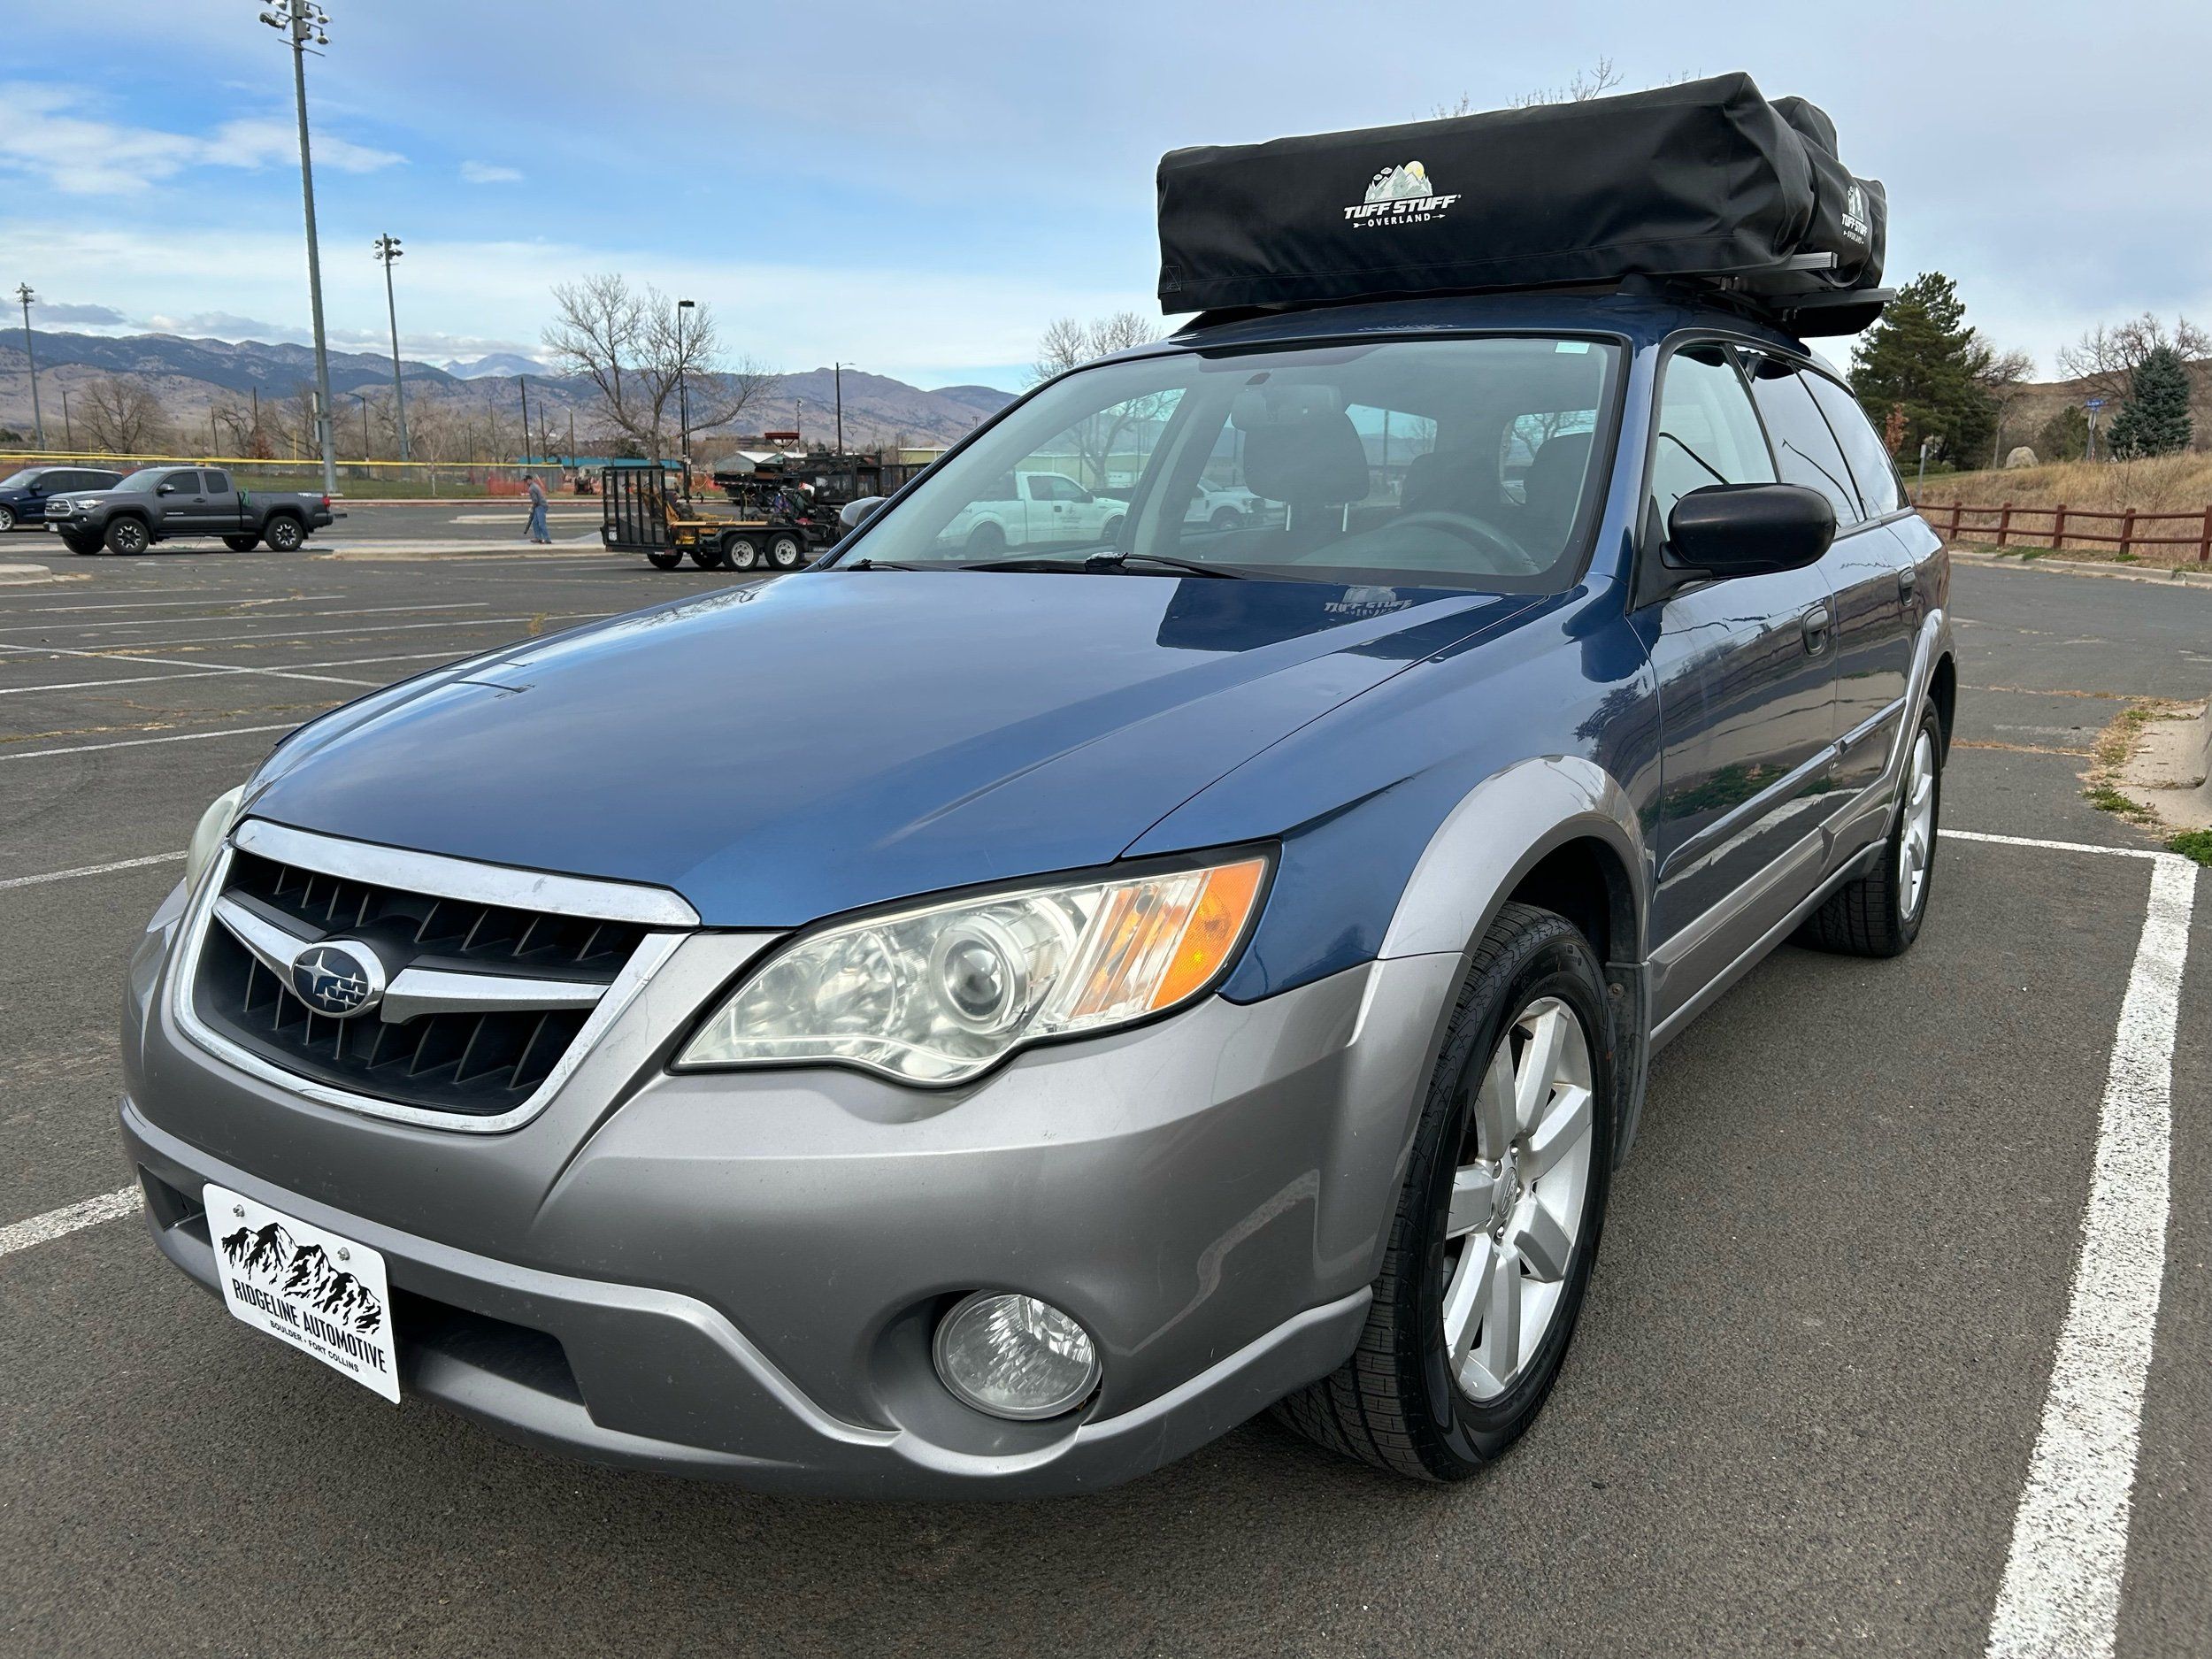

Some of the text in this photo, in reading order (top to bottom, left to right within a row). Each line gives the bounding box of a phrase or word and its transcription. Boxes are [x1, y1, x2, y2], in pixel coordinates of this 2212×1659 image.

[1343, 194, 1457, 219] TUFF STUFF
[1367, 213, 1432, 227] OVERLAND
[232, 1278, 387, 1373] RIDGELINE AUTOMOTIVE
[270, 1319, 359, 1372] BOULDER FORT COLLINS
